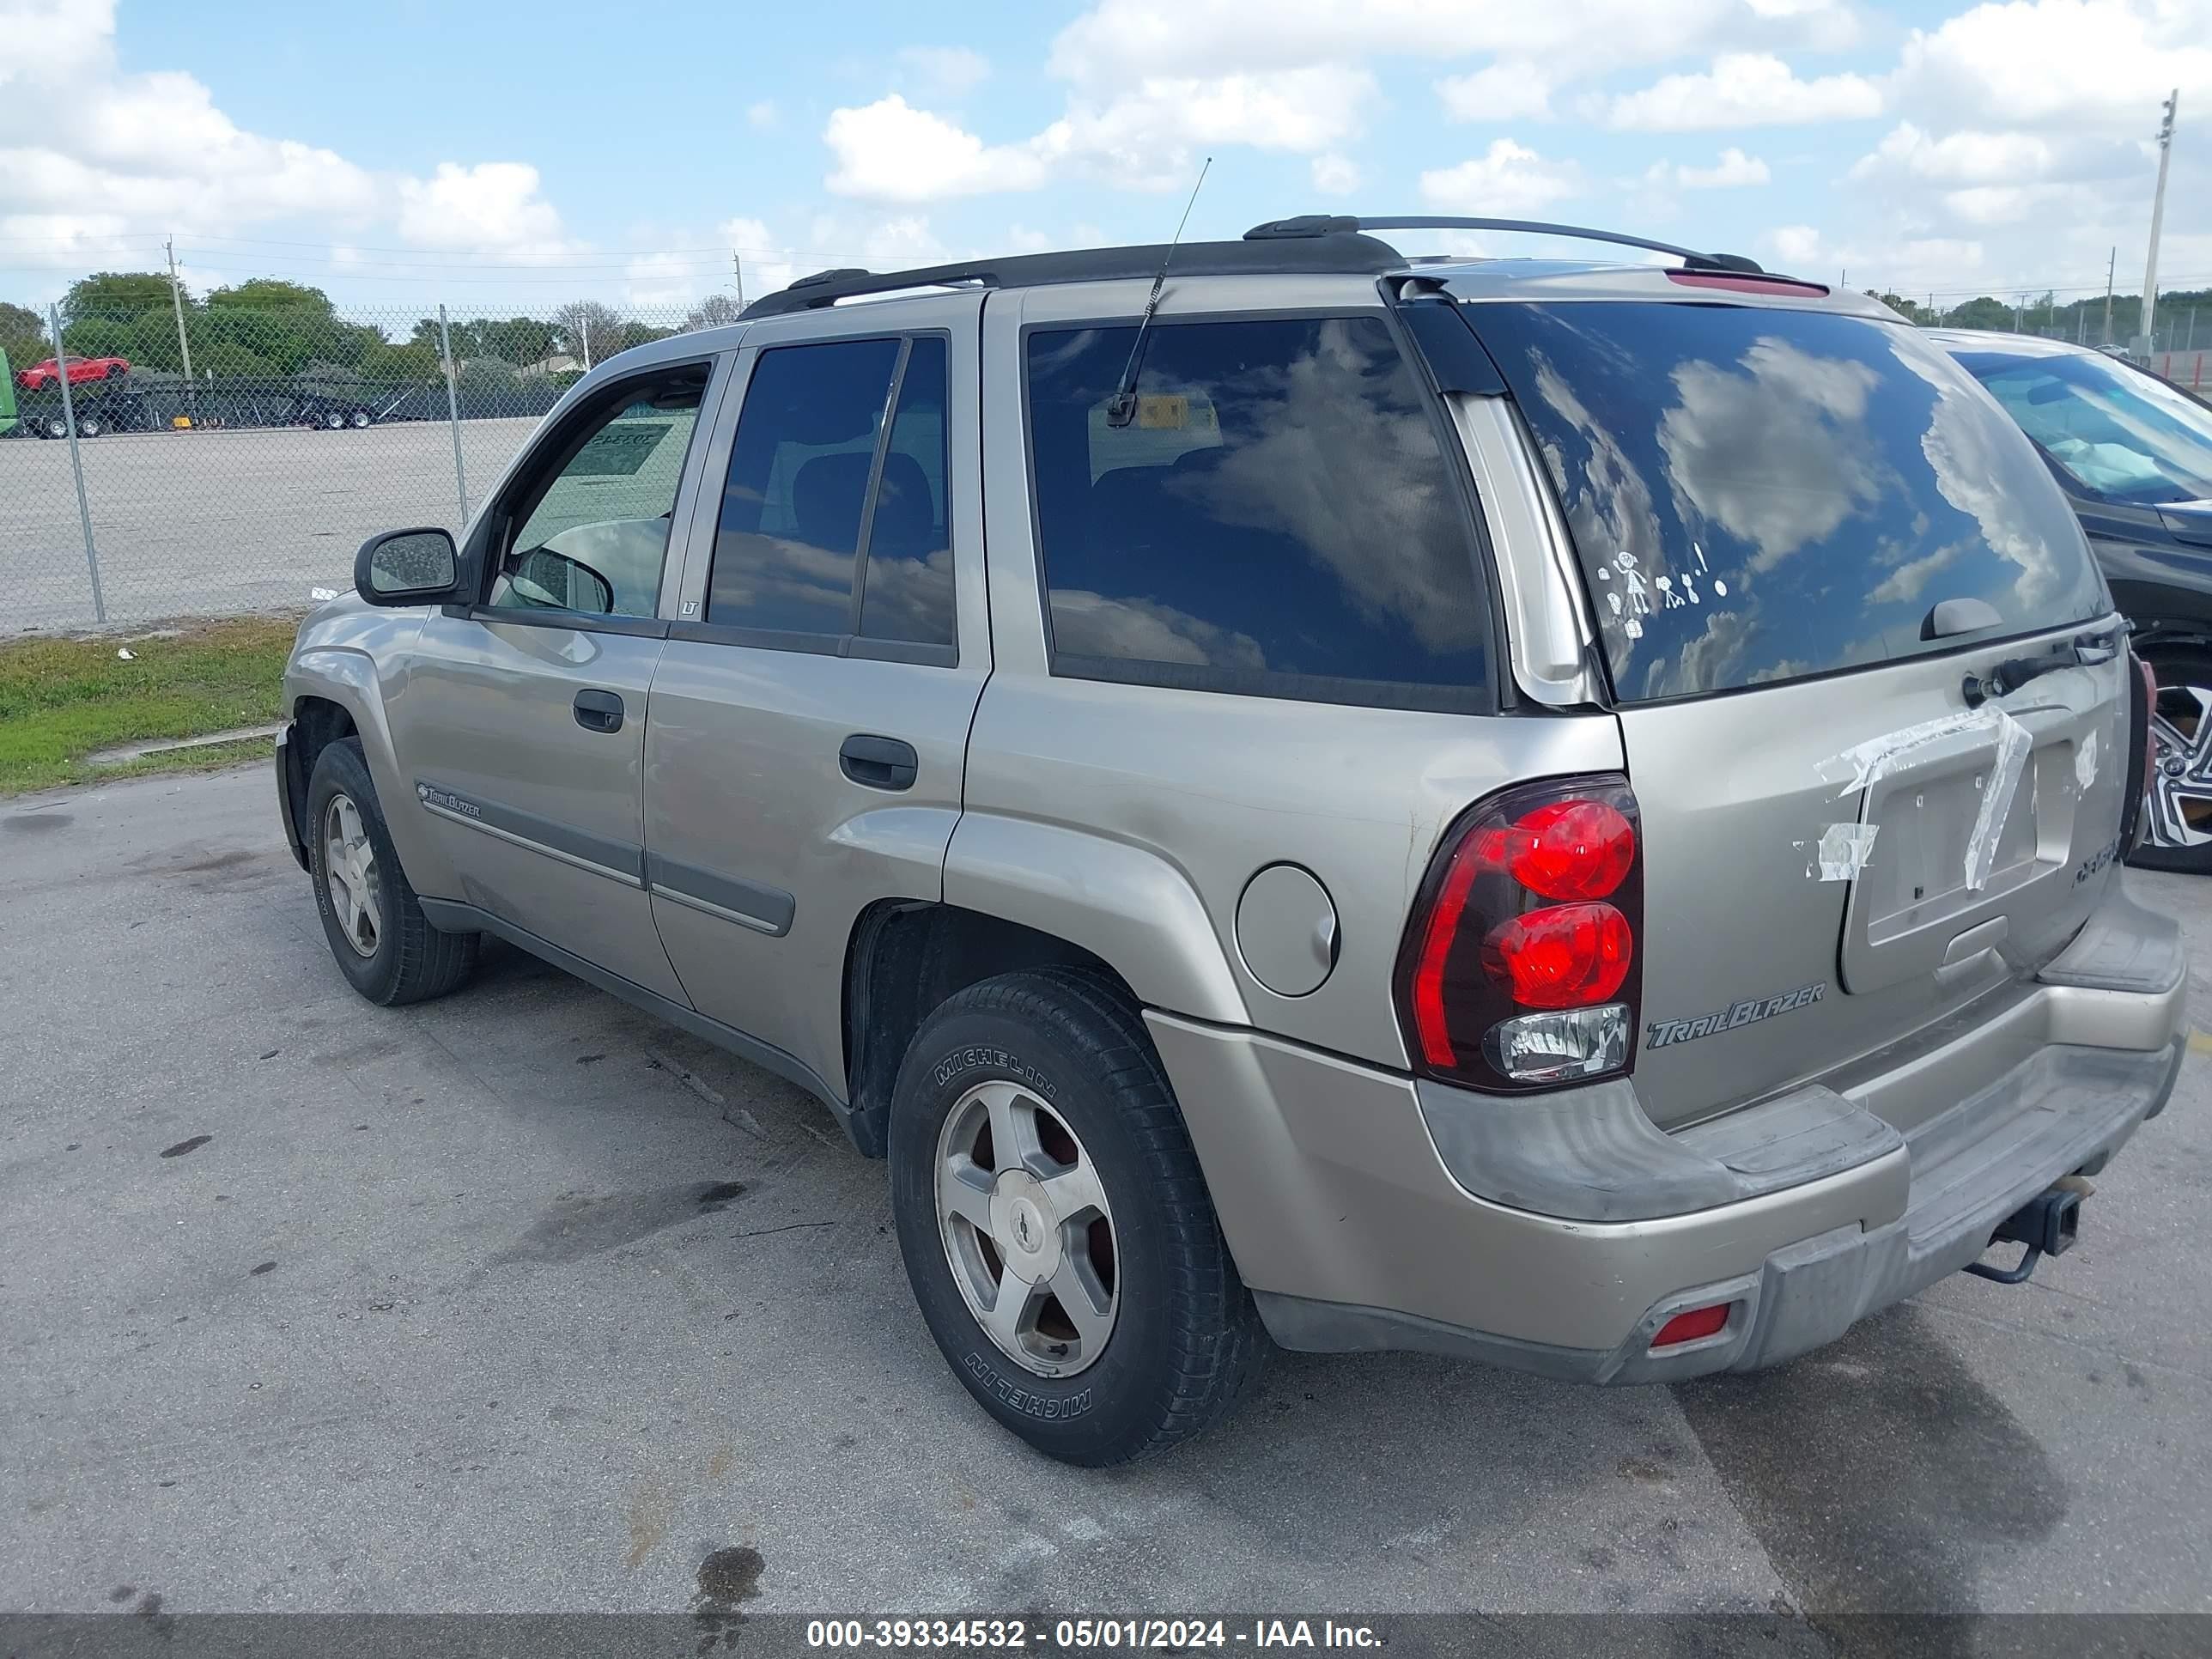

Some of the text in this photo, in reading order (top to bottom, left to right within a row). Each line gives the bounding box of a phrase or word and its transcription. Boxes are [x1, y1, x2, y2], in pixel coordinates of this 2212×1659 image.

[682, 601, 699, 615] LT
[428, 787, 481, 817] TRAILBLAZER
[1647, 981, 1826, 1049] TRAILBLAZER
[933, 1048, 1057, 1098] MICHELIN
[964, 1352, 1092, 1418] MICHELIN
